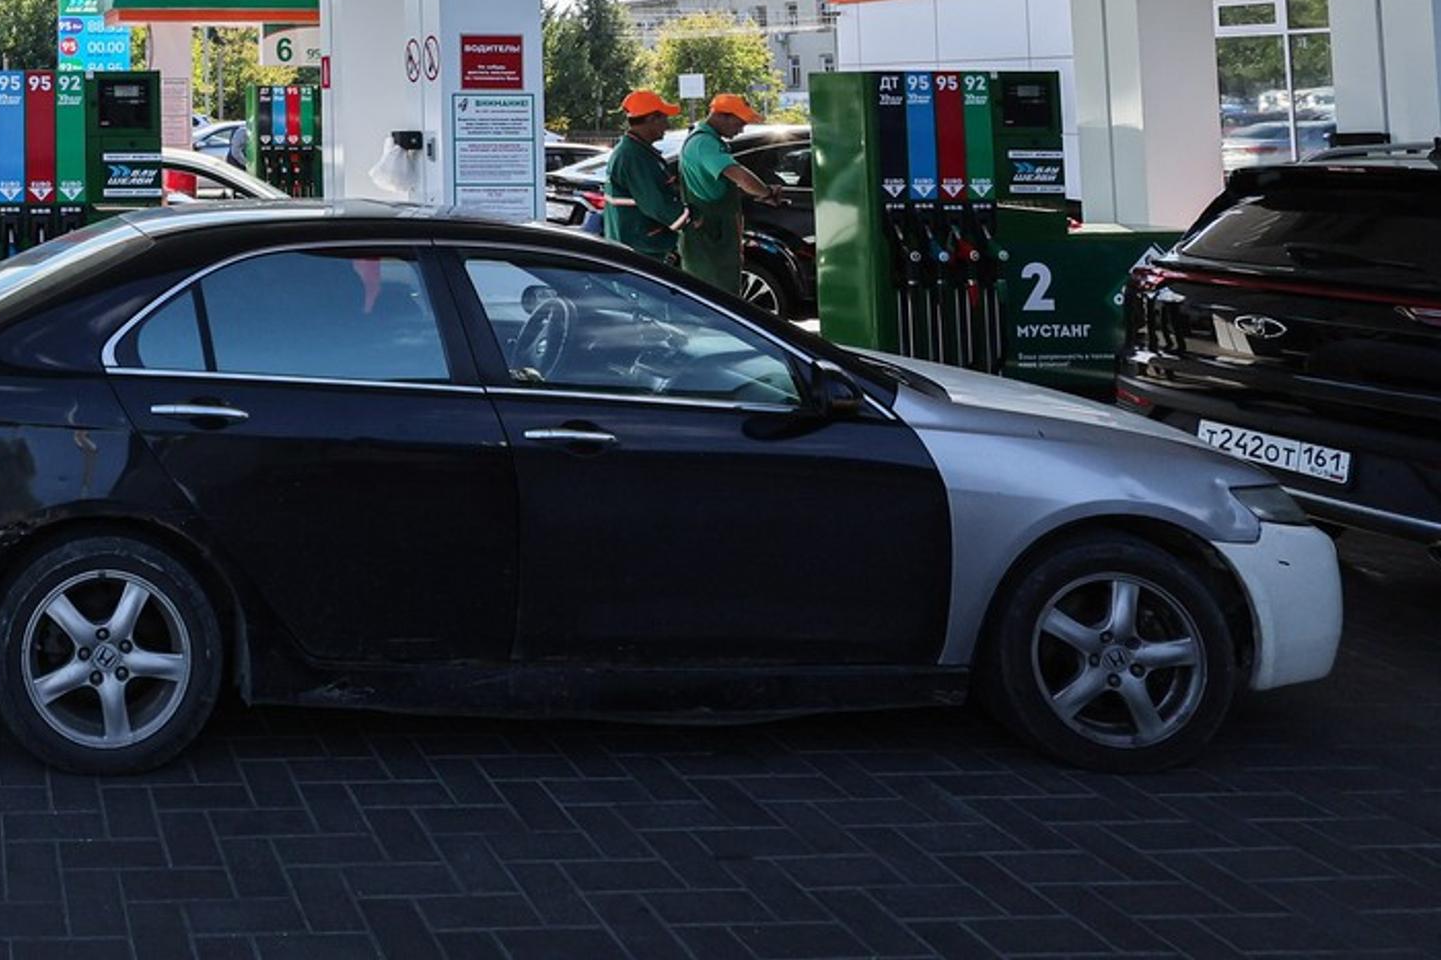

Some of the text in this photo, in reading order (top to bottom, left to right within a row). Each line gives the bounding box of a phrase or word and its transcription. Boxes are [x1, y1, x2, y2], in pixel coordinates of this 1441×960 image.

[62, 41, 125, 53] 95 00.00
[276, 37, 293, 62] 6
[28, 75, 51, 90] 95
[59, 75, 81, 90] 92
[879, 76, 899, 91] ДТ
[907, 75, 929, 90] 95
[936, 75, 959, 90] 95
[964, 75, 986, 90] 92
[1021, 262, 1055, 311] 2
[1017, 324, 1091, 337] МУСТАНГ
[1207, 428, 1342, 472] Т242ОТ 161
